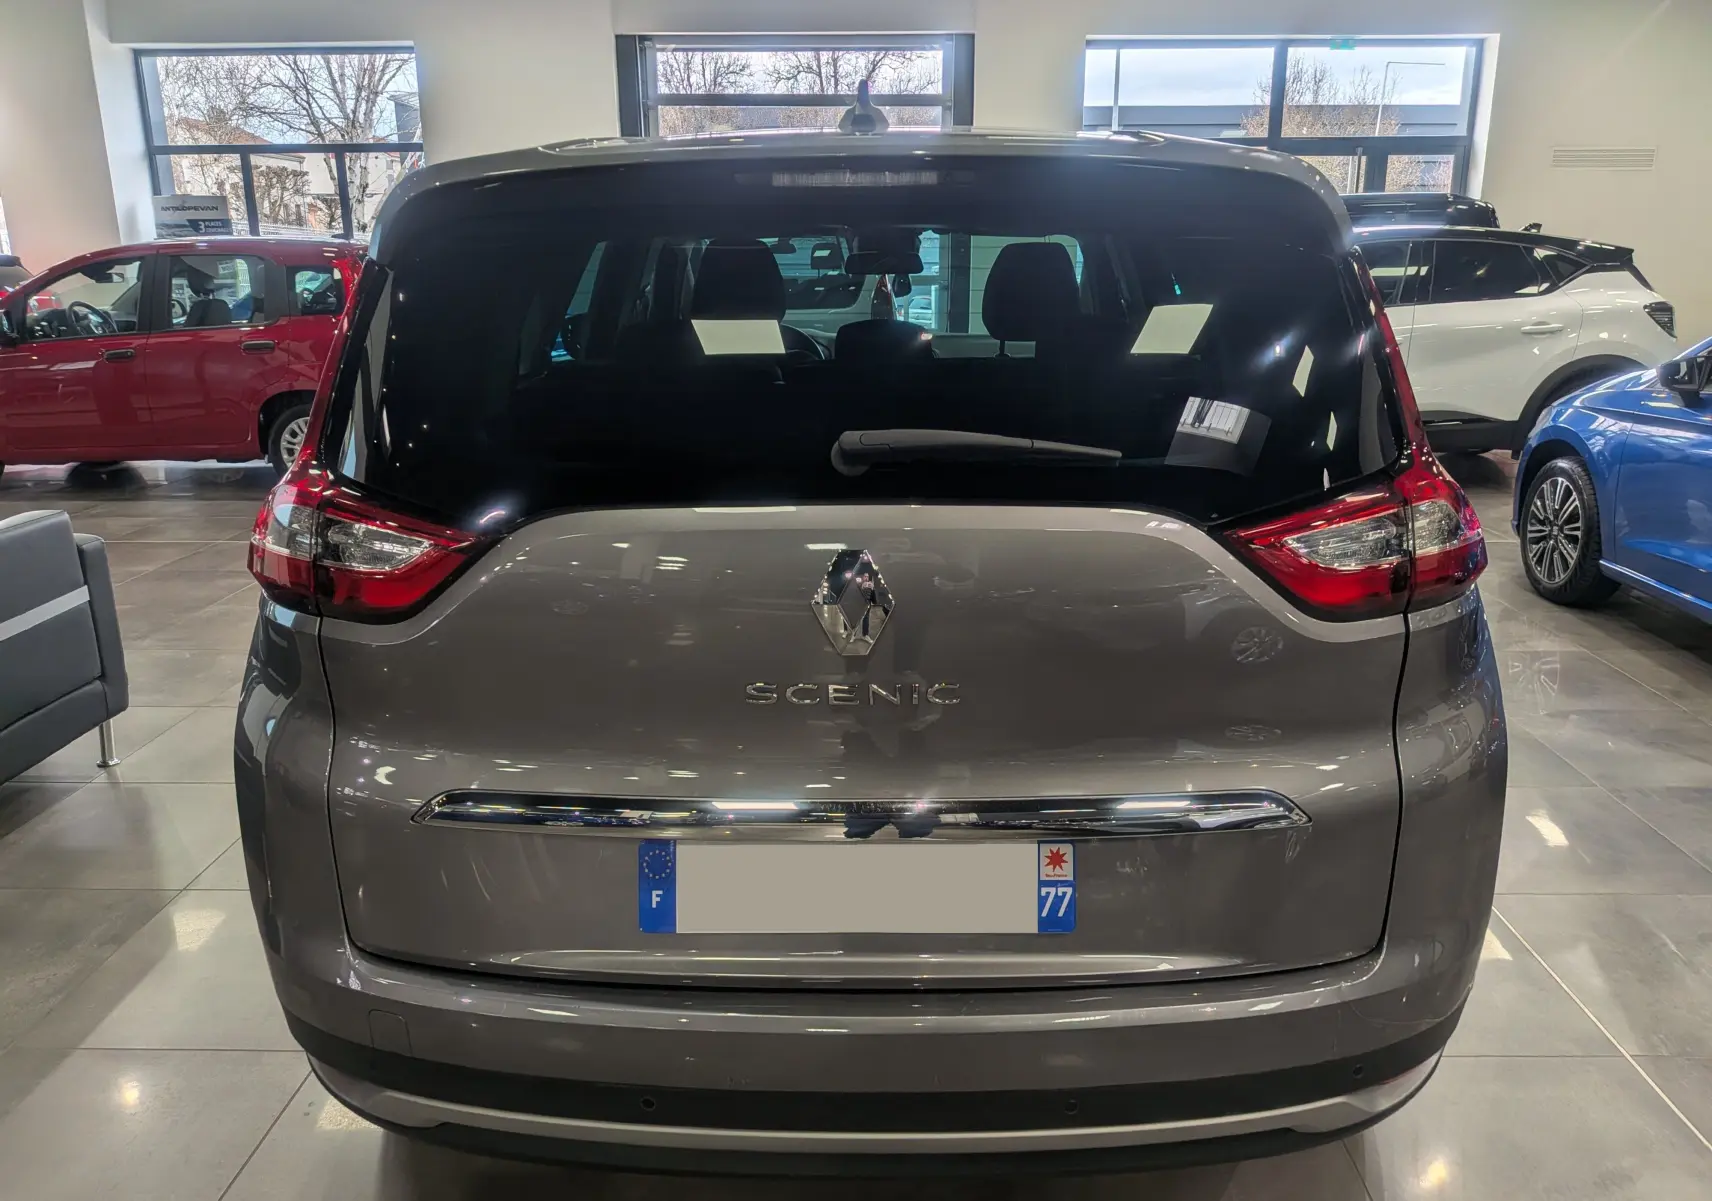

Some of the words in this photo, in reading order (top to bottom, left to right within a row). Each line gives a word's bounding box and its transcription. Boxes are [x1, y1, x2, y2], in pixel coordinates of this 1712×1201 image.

[197, 221, 205, 233] 3
[746, 683, 960, 706] SCENIC
[651, 890, 663, 909] F
[1040, 886, 1073, 917] 77
